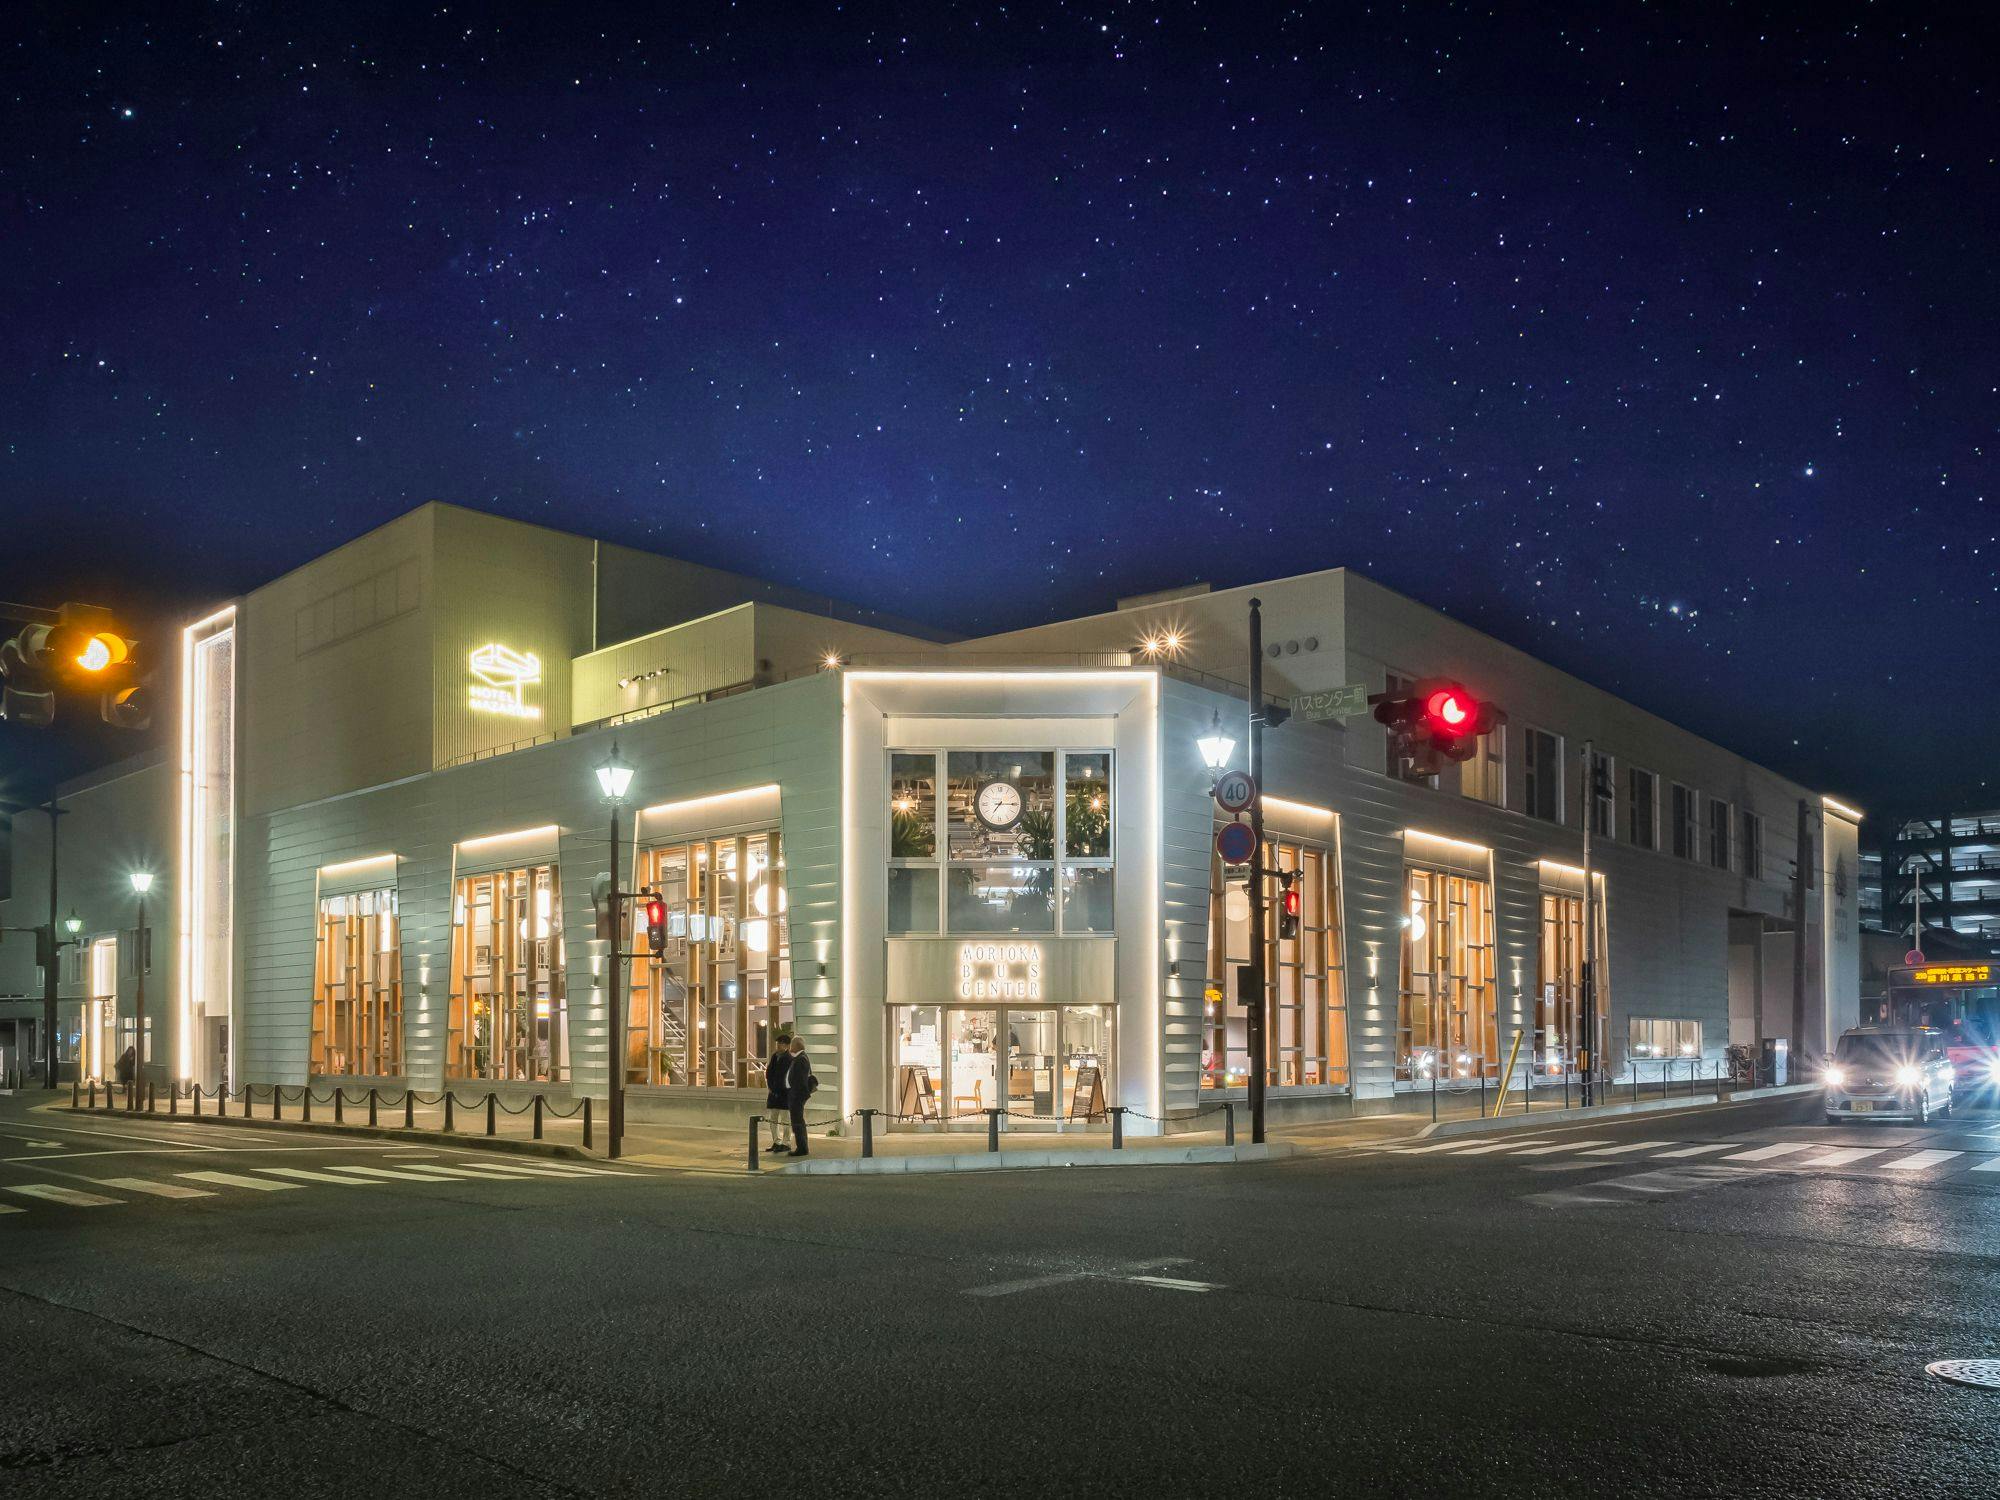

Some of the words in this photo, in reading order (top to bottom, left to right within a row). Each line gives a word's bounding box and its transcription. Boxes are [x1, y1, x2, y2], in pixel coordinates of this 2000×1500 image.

[1225, 782, 1247, 802] 40
[962, 946, 1039, 961] MORIOKA
[962, 964, 1039, 978] BUS
[962, 982, 1039, 997] CENTER
